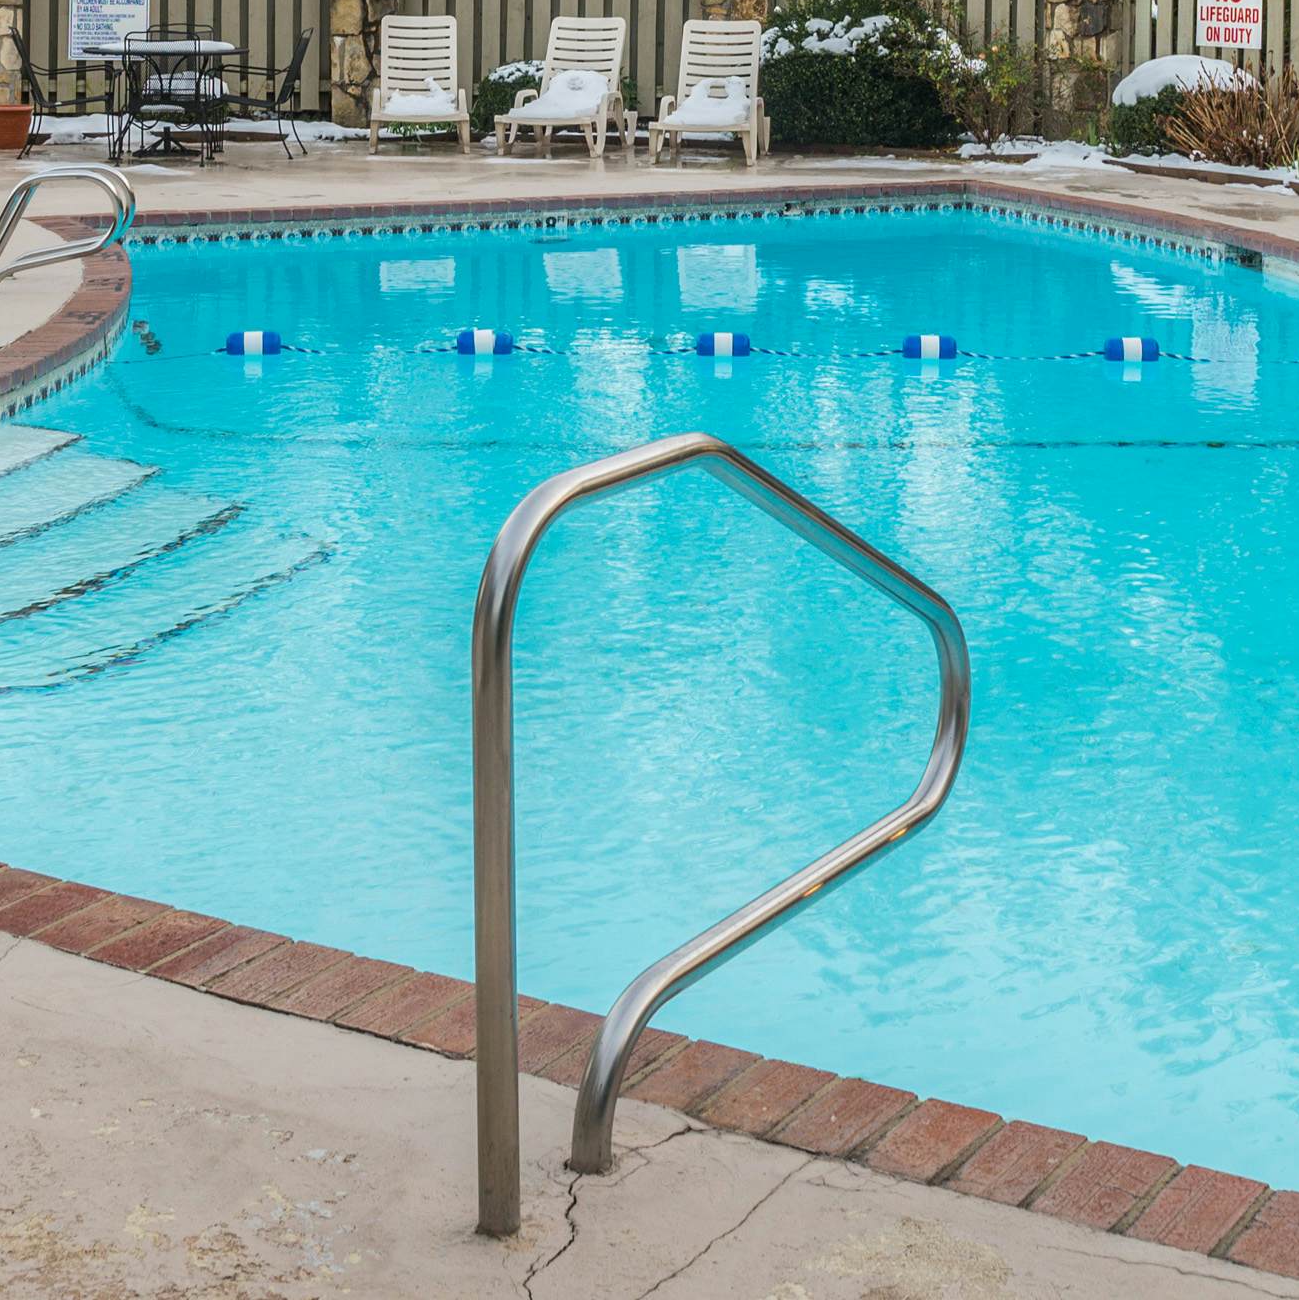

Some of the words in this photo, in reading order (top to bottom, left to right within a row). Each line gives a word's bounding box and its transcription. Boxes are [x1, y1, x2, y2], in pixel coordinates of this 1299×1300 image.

[1200, 6, 1259, 23] LIFEGUARD
[1206, 26, 1220, 42] ON
[1224, 28, 1252, 44] DUTY
